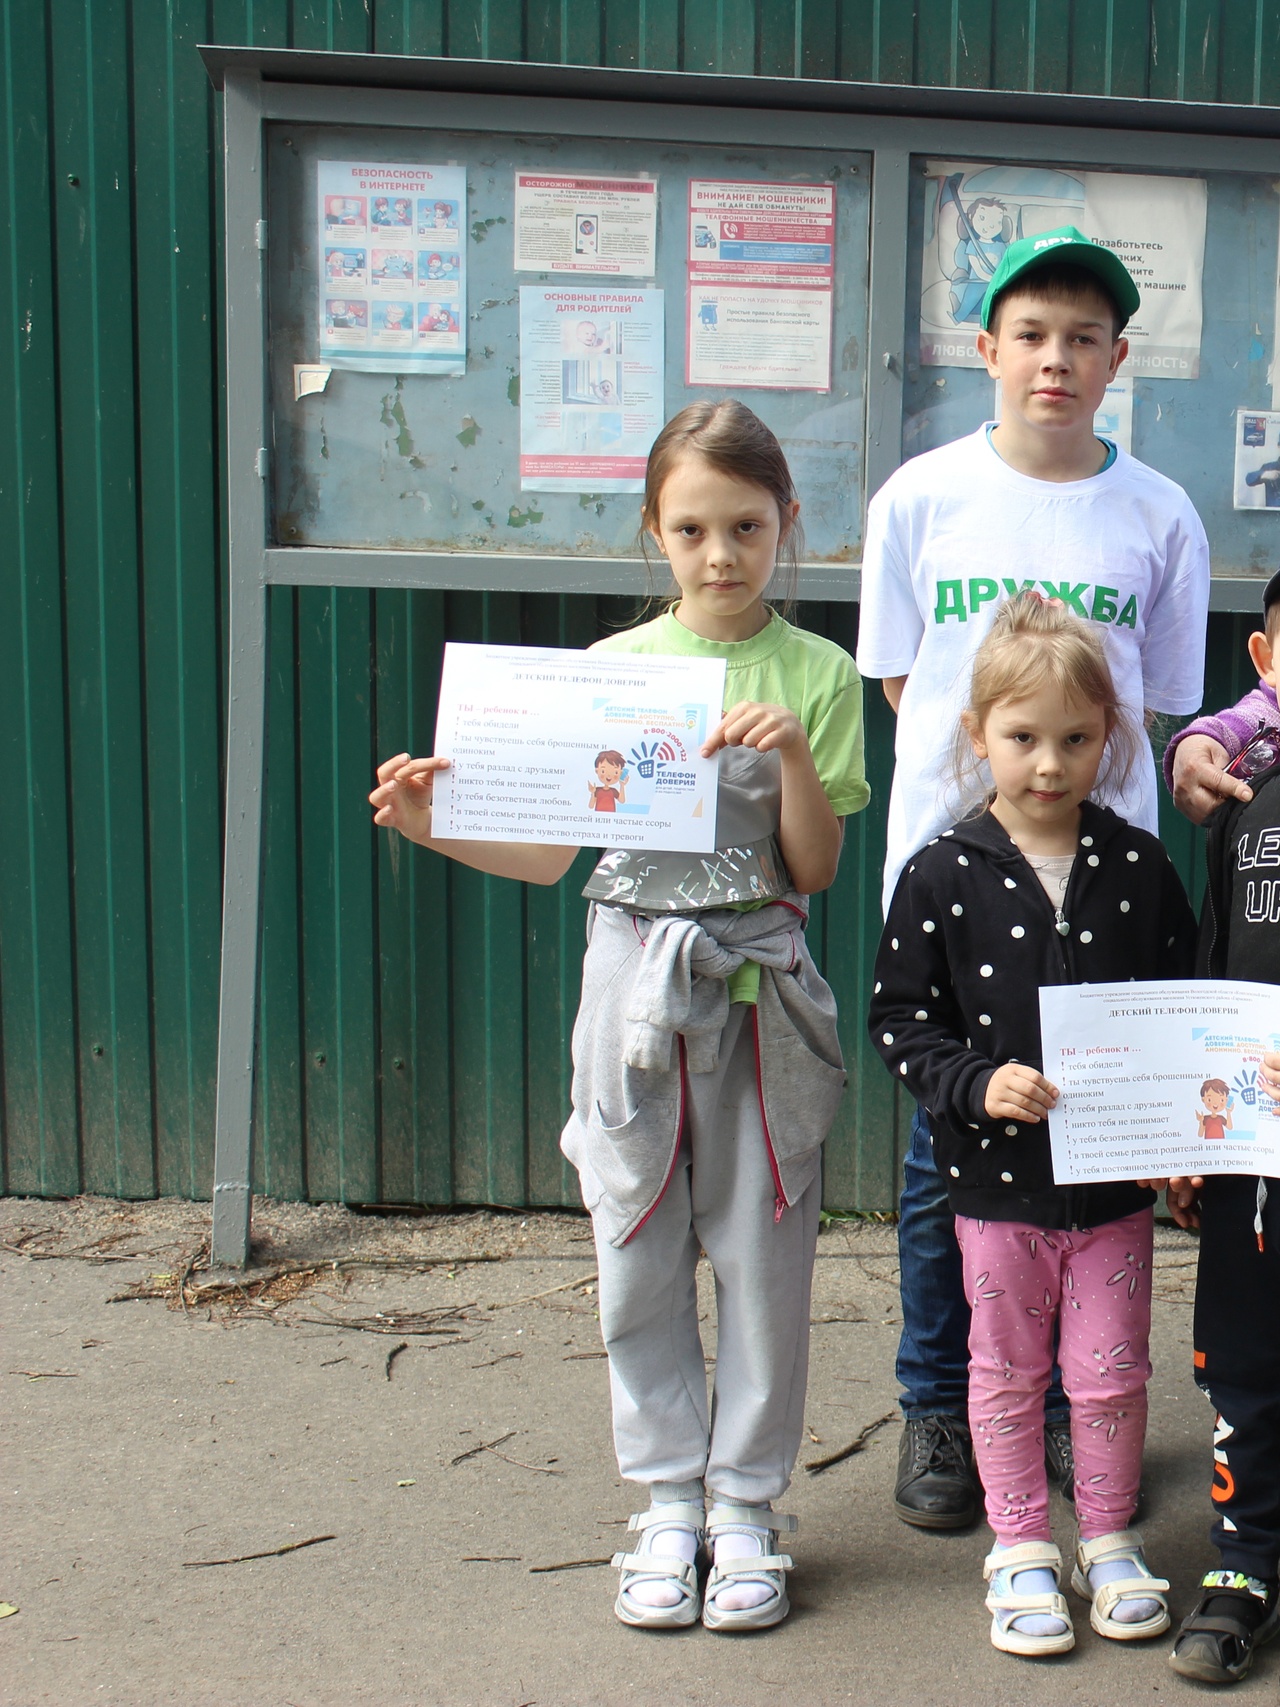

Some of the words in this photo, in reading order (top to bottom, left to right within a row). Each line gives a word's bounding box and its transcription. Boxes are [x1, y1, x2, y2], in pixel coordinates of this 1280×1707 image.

[351, 168, 433, 180] БЕЗОПАСНОСТЬ
[360, 181, 366, 189] В
[369, 181, 426, 192] ИНТЕРНЕТЕ
[525, 181, 575, 189] ОСТОРОЖНО!
[696, 192, 755, 202] ВНИМАНИЕ!
[758, 195, 827, 205] МОШЕННИКИ!
[756, 216, 818, 224] МОШЕННИЧЕСТВА
[1033, 237, 1077, 251] ДРУ
[1091, 237, 1163, 250] Позаботьтесь
[1115, 253, 1145, 264] зких,
[1144, 281, 1187, 291] машине
[544, 293, 597, 302] ОСНОВНЫЕ
[599, 294, 644, 303] ПРАВИЛА
[555, 304, 576, 313] ДЛЯ
[577, 304, 632, 314] РОДИТЕЛЕЙ
[727, 309, 750, 317] Простые
[932, 344, 982, 358] ЛЮБО
[1123, 355, 1188, 369] ЕННОСТЬ
[512, 672, 555, 682] ДЕТСКИЙ
[558, 675, 602, 685] ТЕЛЕФОН
[604, 677, 646, 687] ДОВЕРИЯ
[458, 703, 473, 712] ТЫ
[483, 705, 520, 715] ребенок
[637, 707, 668, 715] ТЕЛЕФОН
[463, 718, 481, 727] тебя
[483, 720, 519, 729] обидели
[646, 720, 685, 728] БЕСПЛАТНО
[460, 735, 472, 744] ты
[474, 734, 525, 745] чувствуешь
[527, 736, 545, 746] себя
[548, 739, 600, 750] брошенным
[452, 747, 496, 756] одиноким
[466, 762, 485, 770] тебя
[487, 764, 515, 773] разлад
[525, 766, 566, 775] друзьями
[656, 770, 696, 779] ТЕЛЕФОН
[458, 777, 484, 786] никто
[486, 778, 505, 786] тебя
[519, 781, 561, 791] понимает
[655, 778, 695, 787] ДОВЕРИЯ
[465, 792, 484, 801] тебя
[486, 793, 537, 804] безответная
[539, 797, 572, 806] любовь
[464, 807, 489, 817] твоей
[490, 810, 516, 819] семье
[518, 811, 547, 822] развод
[548, 812, 593, 824] родителей
[595, 816, 611, 824] или
[613, 817, 643, 827] частые
[645, 820, 672, 830] ссоры
[463, 822, 482, 832] тебя
[485, 824, 535, 835] постоянное
[537, 827, 570, 837] чувство
[572, 830, 601, 840] страха
[611, 832, 644, 842] тревоги
[1109, 1007, 1152, 1018] ДЕТСКИЙ
[1153, 1006, 1197, 1015] ТЕЛЕФОН
[1199, 1006, 1239, 1015] ДОВЕРИЯ
[1060, 1047, 1076, 1056] ТЫ
[1086, 1045, 1121, 1056] ребенок
[1068, 1061, 1086, 1071] тебя
[1089, 1060, 1123, 1070] обидели
[1069, 1077, 1080, 1087] ты
[1082, 1076, 1131, 1087] чувствуешь
[1132, 1073, 1150, 1082] себя
[1152, 1072, 1203, 1084] брошенным
[1063, 1090, 1104, 1100] одиноким
[1077, 1104, 1095, 1113] тебя
[1098, 1103, 1125, 1113] разлад
[1133, 1101, 1173, 1112] друзьями
[1072, 1120, 1096, 1129] никто
[1098, 1118, 1116, 1127] тебя
[1130, 1116, 1170, 1126] понимает
[1080, 1134, 1097, 1143] тебя
[1099, 1132, 1148, 1143] безответная
[1150, 1130, 1182, 1140] любовь
[1081, 1150, 1104, 1159] твоей
[1105, 1150, 1129, 1158] семье
[1131, 1148, 1158, 1158] развод
[1160, 1144, 1203, 1157] родителей
[1223, 1143, 1251, 1152] частые
[1253, 1146, 1275, 1156] ссоры
[1083, 1166, 1100, 1174] тебя
[1102, 1164, 1149, 1174] постоянное
[1150, 1161, 1183, 1172] чувство
[1185, 1159, 1212, 1169] страха
[1222, 1158, 1254, 1168] тревоги
